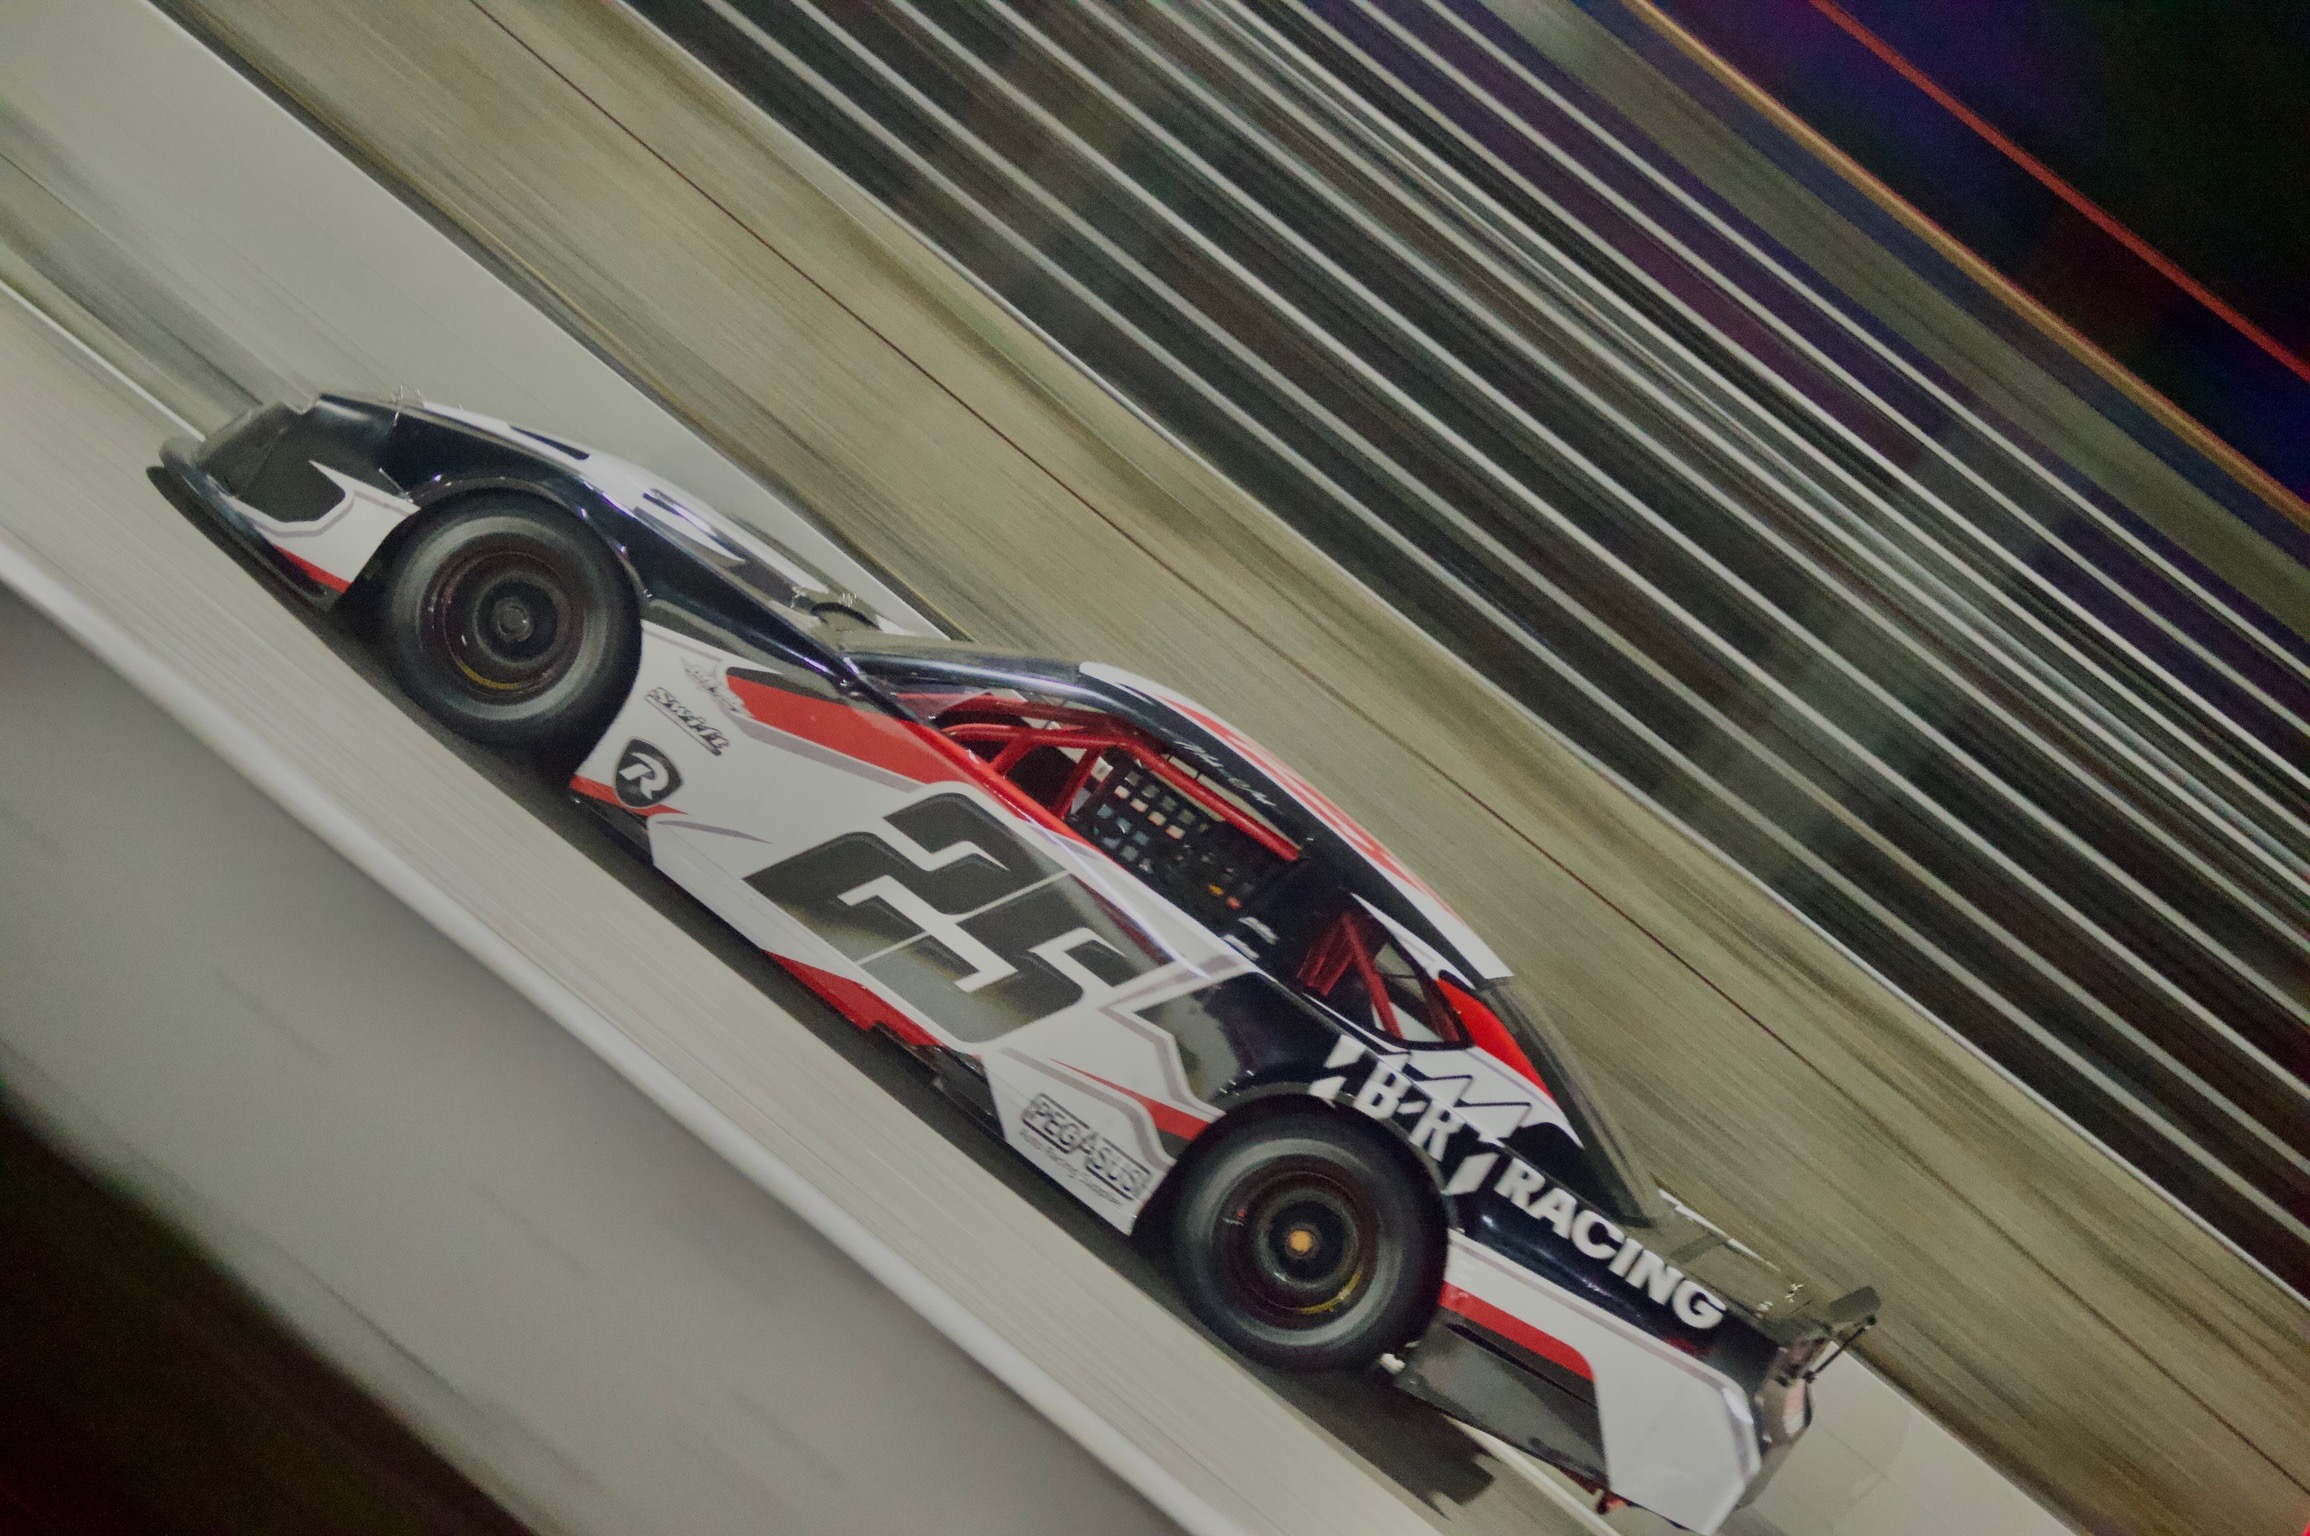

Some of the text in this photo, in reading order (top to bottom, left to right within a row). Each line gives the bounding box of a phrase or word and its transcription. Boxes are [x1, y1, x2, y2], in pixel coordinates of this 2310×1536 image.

[618, 752, 669, 801] R
[741, 792, 1177, 1044] 25
[1024, 1098, 1147, 1197] PEGASUS
[1494, 1157, 1727, 1330] RACING
